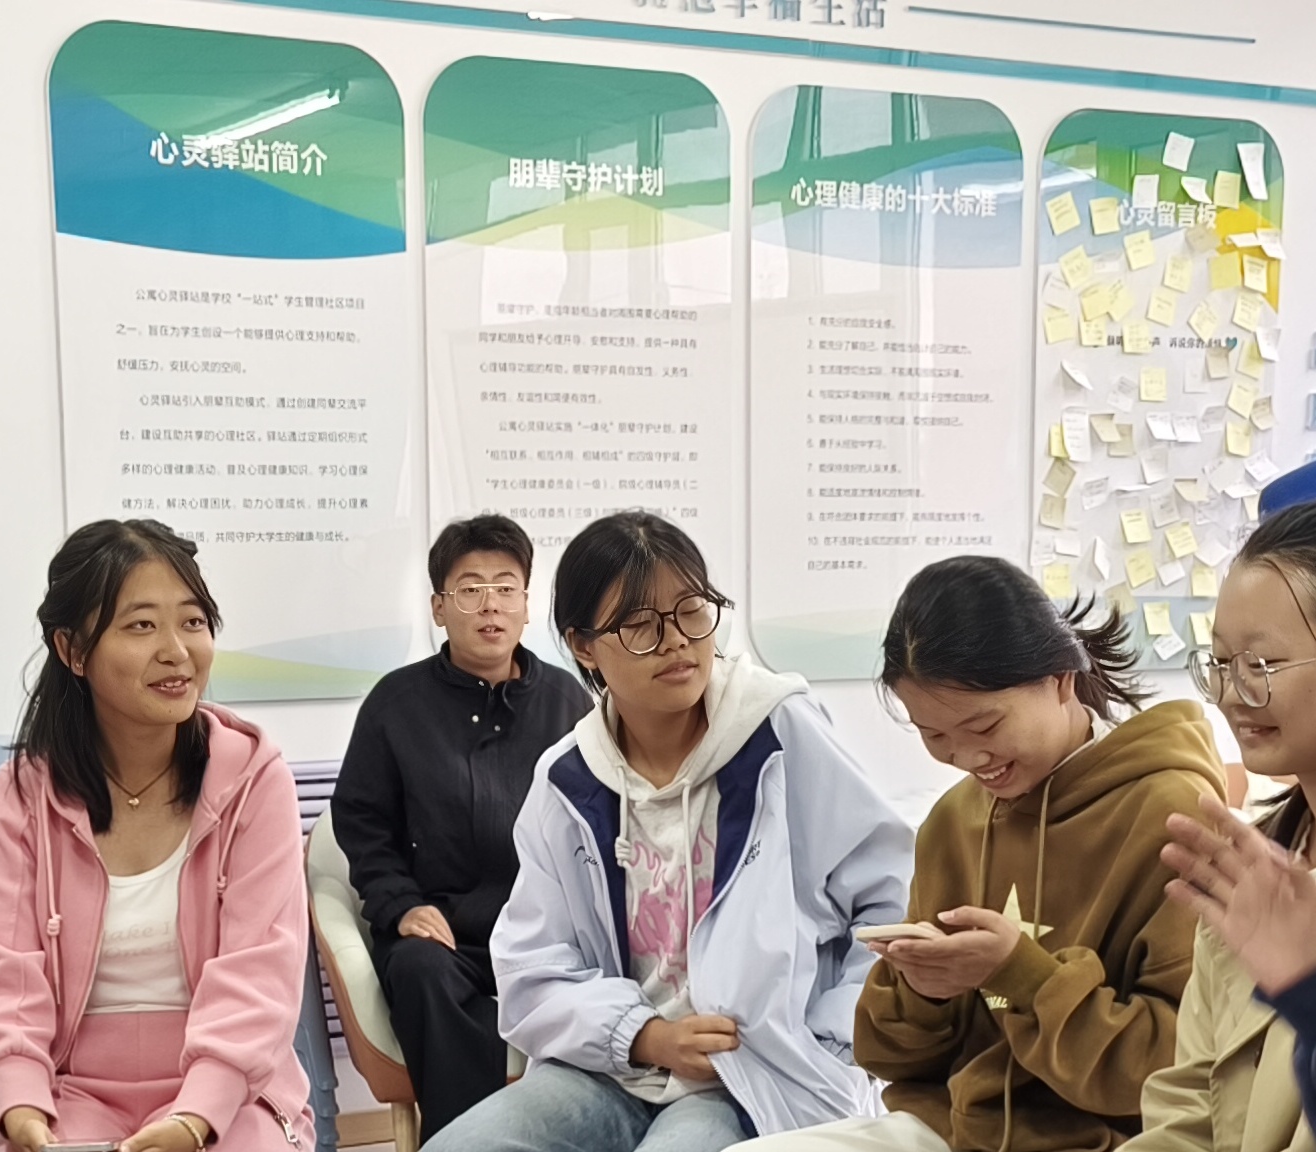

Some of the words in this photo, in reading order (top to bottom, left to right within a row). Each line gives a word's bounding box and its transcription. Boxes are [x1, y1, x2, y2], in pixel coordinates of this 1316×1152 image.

[150, 132, 328, 176] 心灵驿站简介
[509, 157, 664, 196] 朋辈守护计划
[790, 177, 997, 217] 心理健康的十大标准
[1118, 199, 1217, 229] 心灵留言板
